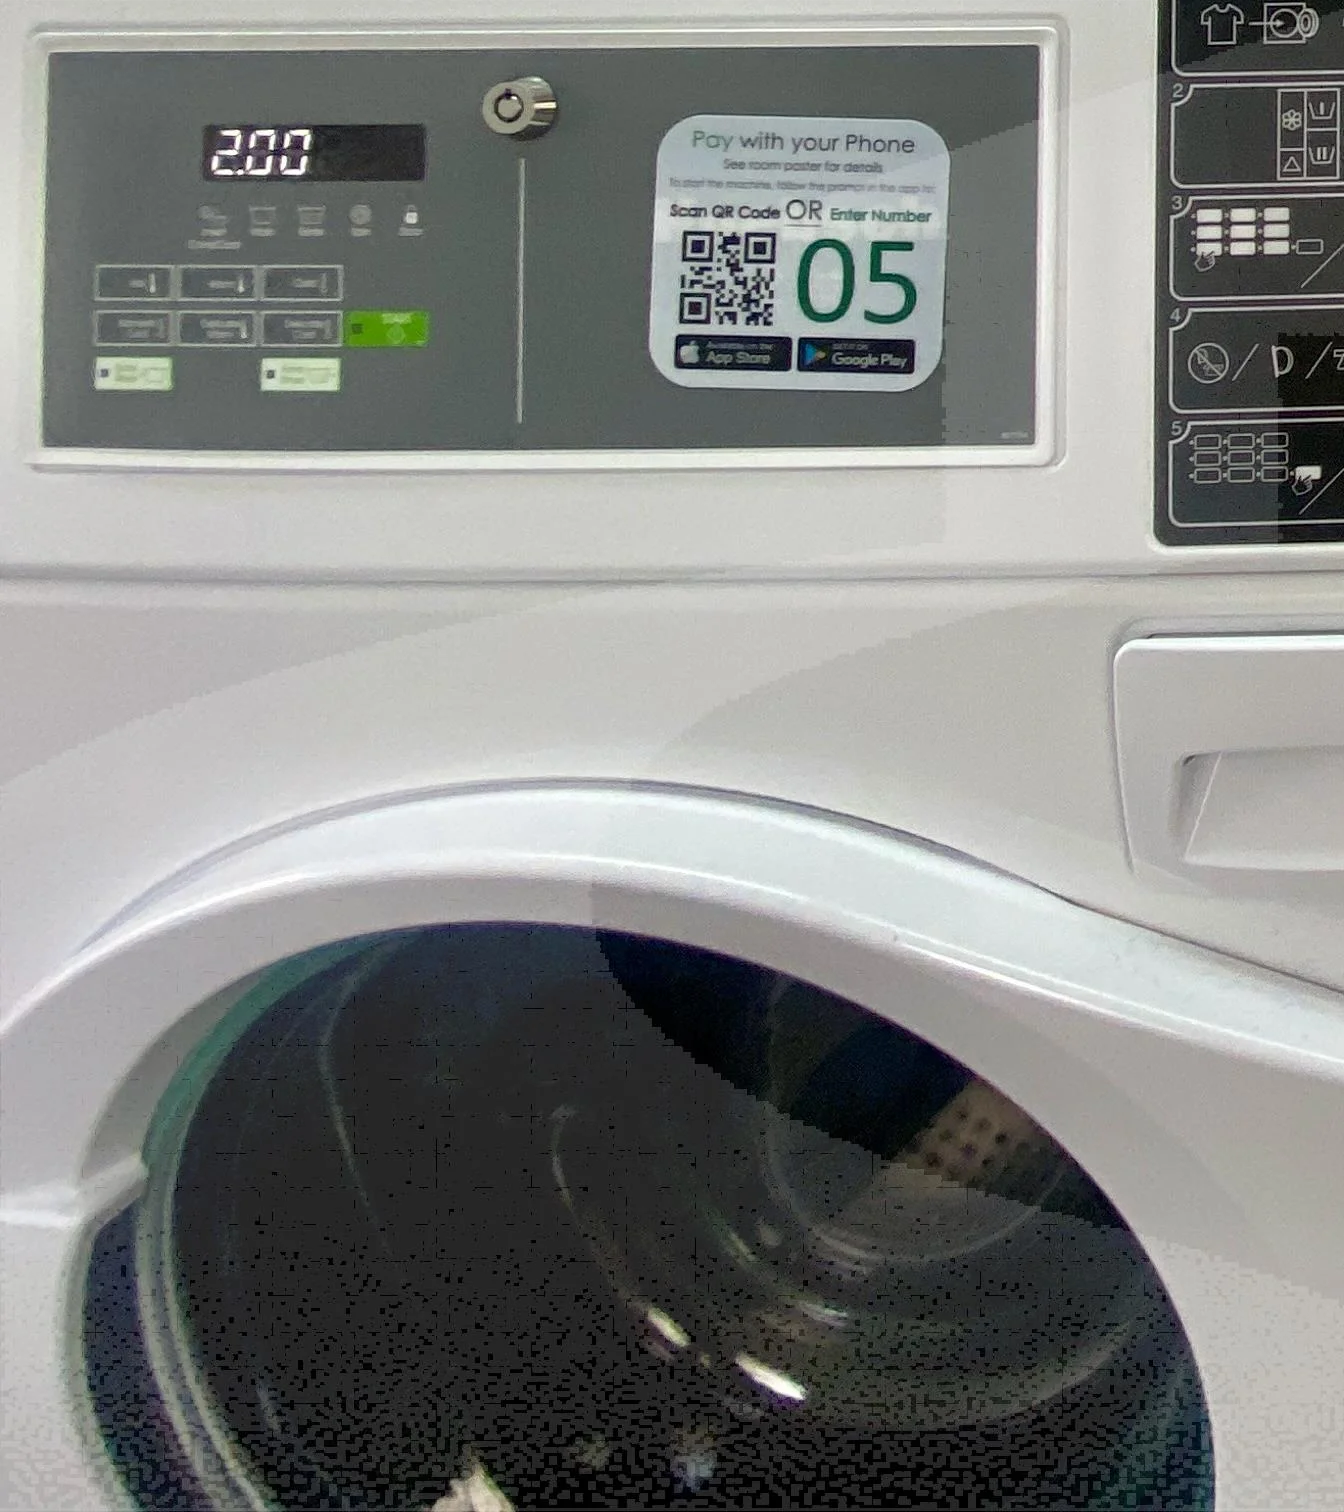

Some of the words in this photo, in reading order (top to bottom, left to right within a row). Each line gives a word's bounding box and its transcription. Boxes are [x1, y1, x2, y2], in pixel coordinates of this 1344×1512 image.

[211, 129, 312, 176] 2.00
[692, 130, 734, 150] Pay
[739, 133, 784, 150] with
[791, 137, 837, 154] your
[845, 134, 915, 153] Phone
[669, 204, 707, 218] Scan
[711, 205, 734, 218] QR
[738, 206, 780, 219] Code
[785, 198, 822, 221] OR
[830, 208, 867, 221] Enter
[871, 208, 932, 222] Number
[797, 238, 917, 324] 05
[705, 352, 732, 364] App
[736, 352, 770, 364] Store
[832, 352, 878, 368] Google
[881, 354, 907, 367] Play
